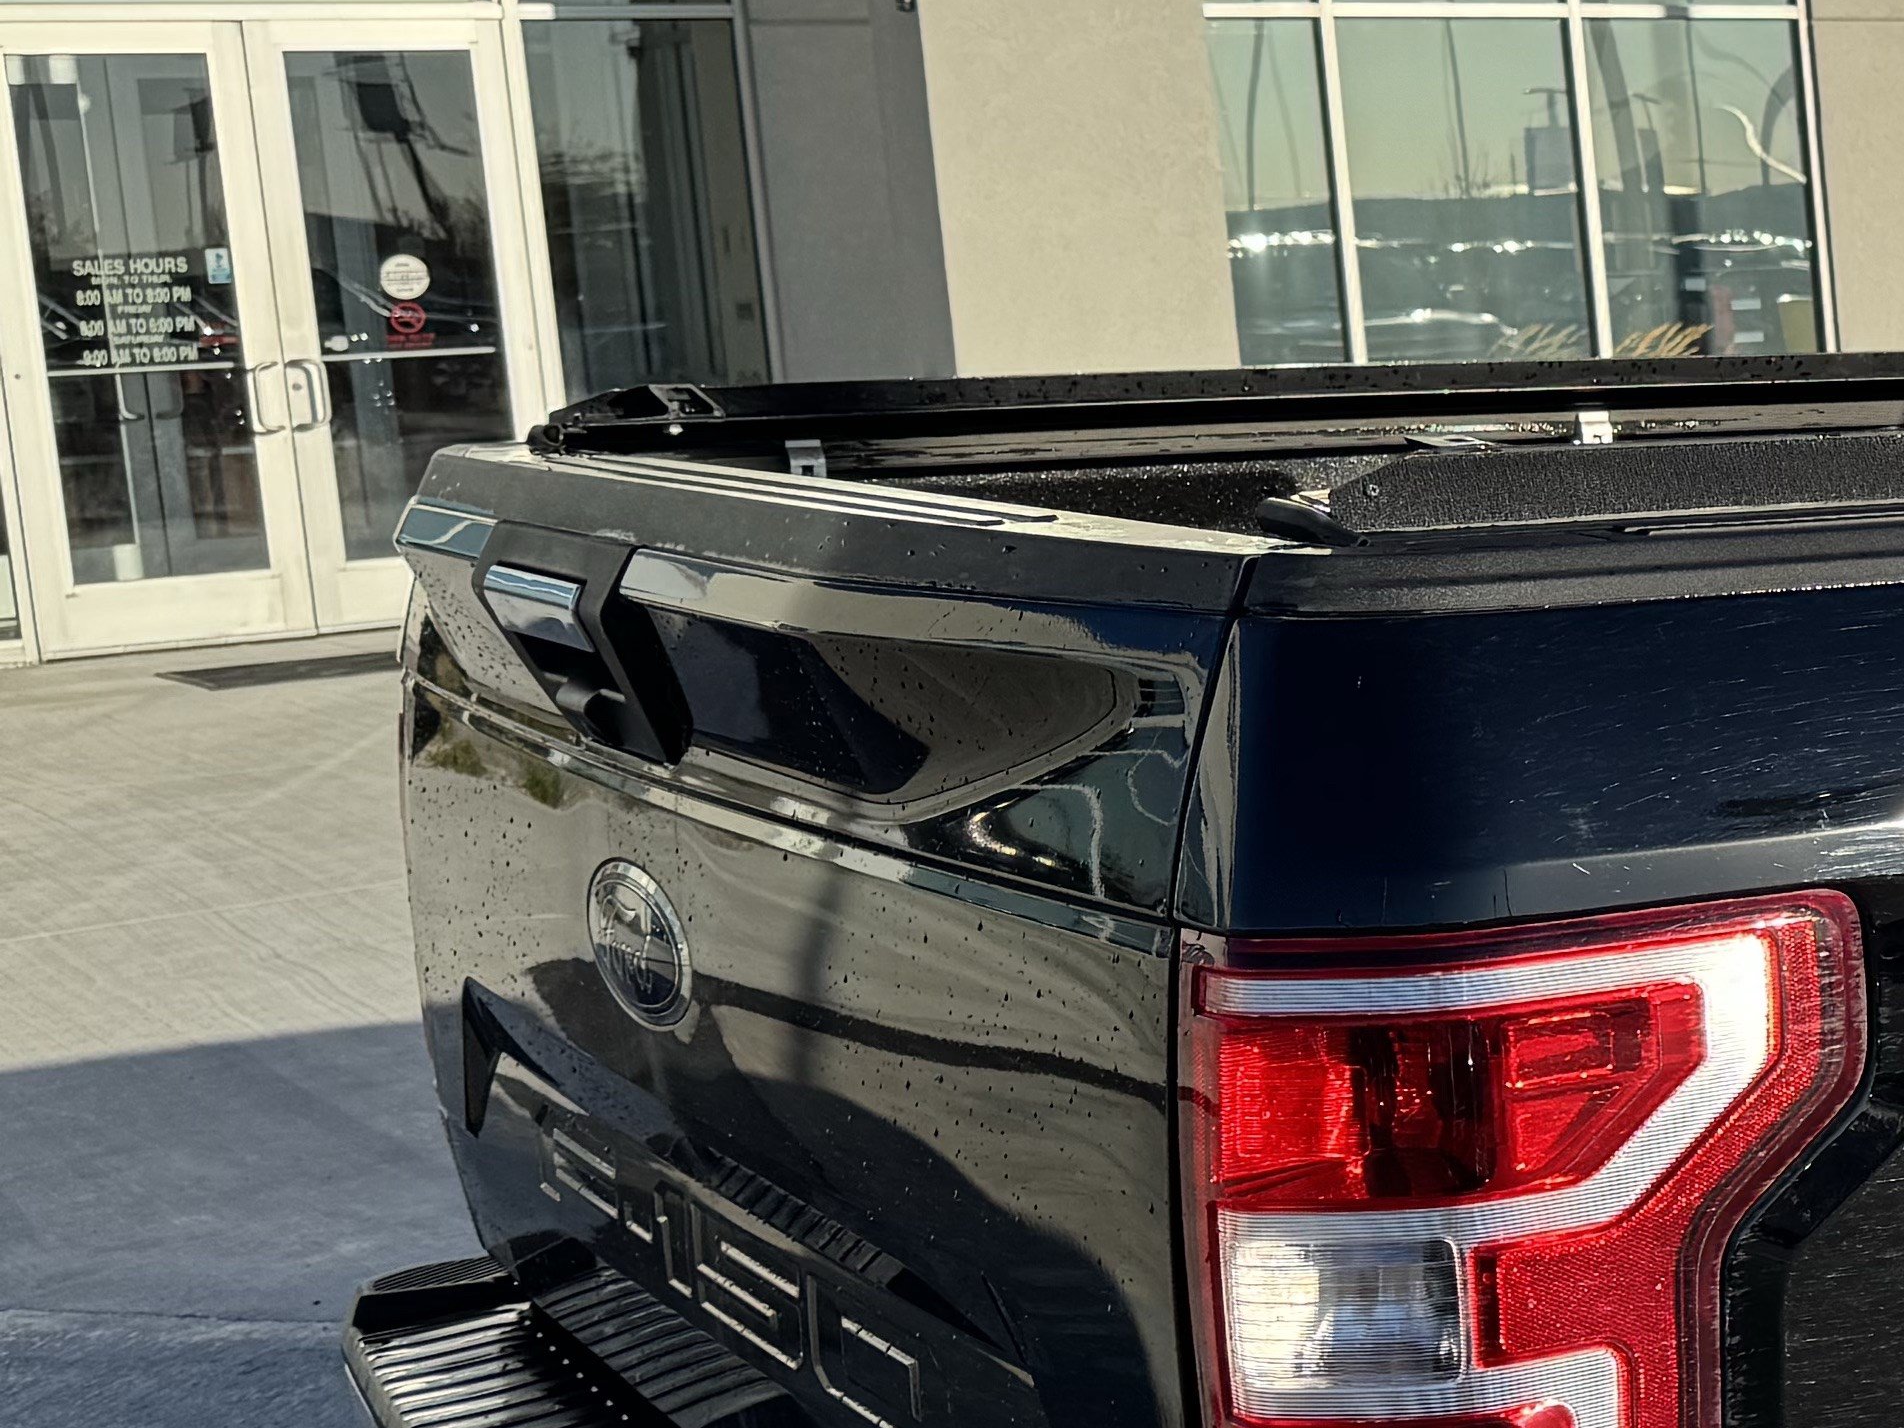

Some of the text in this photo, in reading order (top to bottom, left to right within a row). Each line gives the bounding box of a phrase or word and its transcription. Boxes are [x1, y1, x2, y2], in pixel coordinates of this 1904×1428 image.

[72, 256, 188, 276] SALES HOURS
[124, 275, 138, 284] TO
[106, 287, 123, 304] AM
[126, 287, 143, 303] TO
[172, 286, 192, 302] PM
[110, 319, 127, 334] AM
[129, 318, 147, 334] TO
[176, 315, 196, 332] PM
[111, 348, 131, 364] AM
[133, 347, 150, 363] TO
[179, 345, 198, 361] PM
[601, 895, 653, 996] Ford
